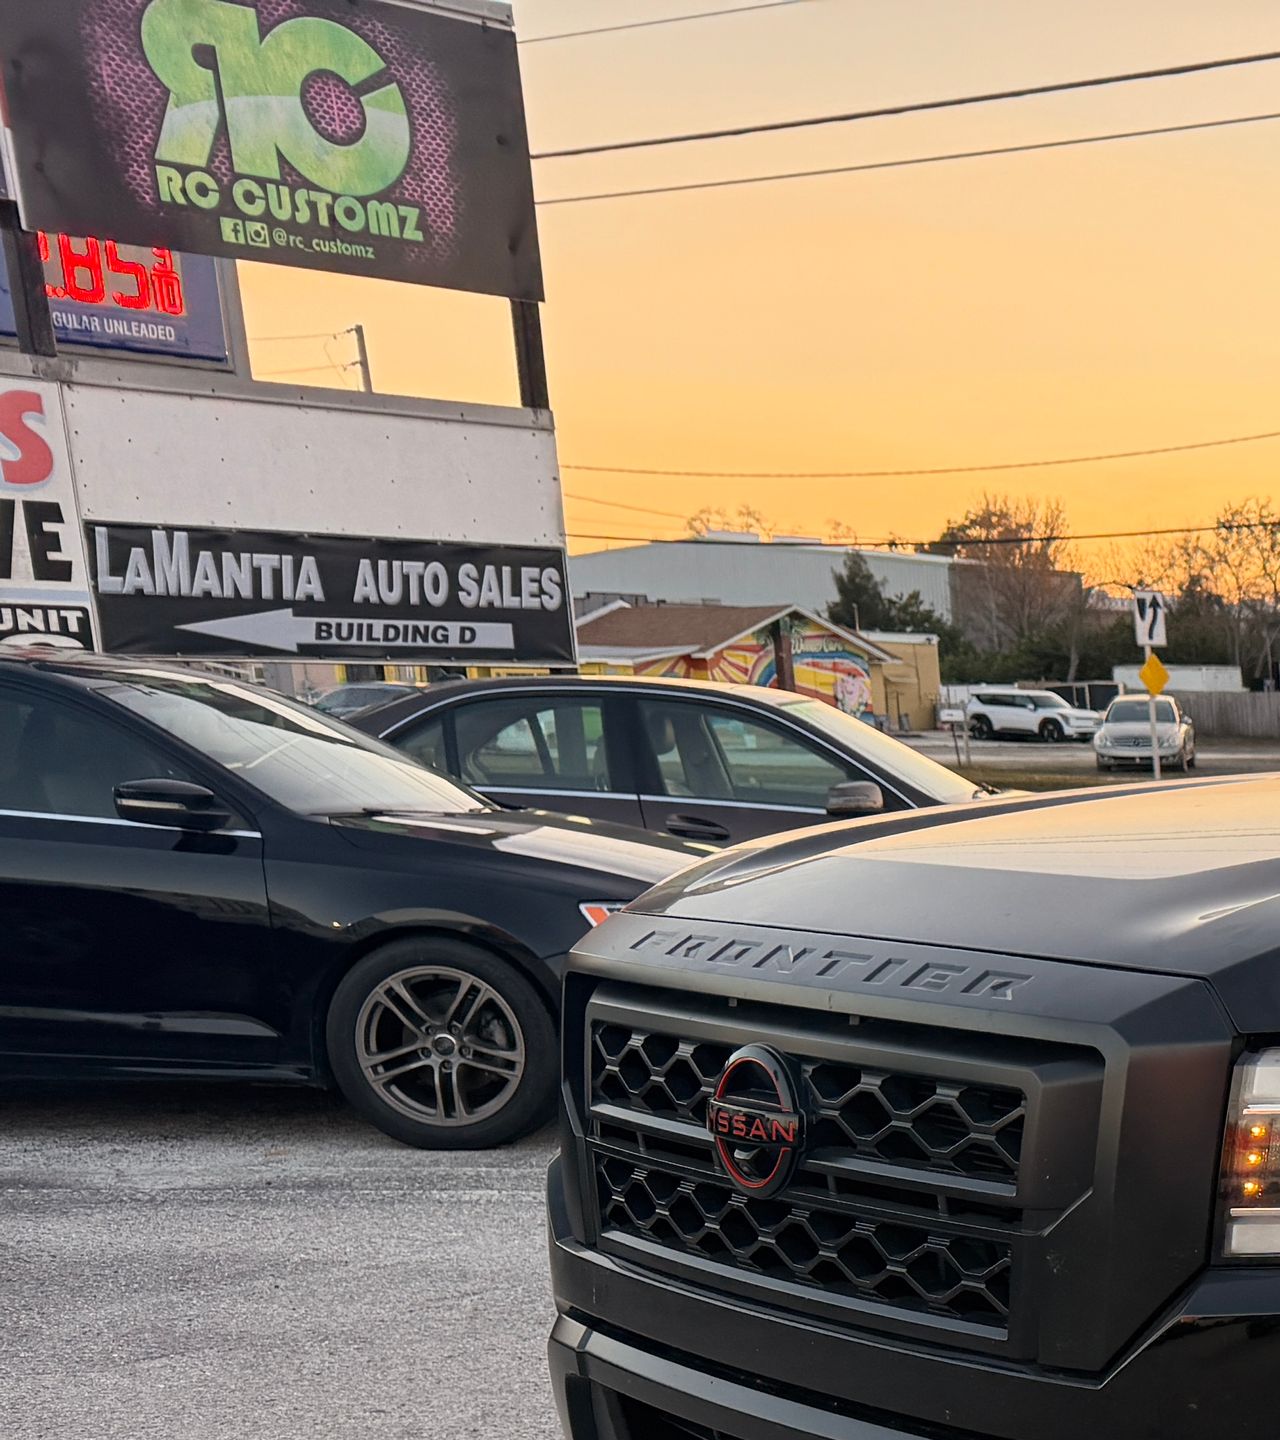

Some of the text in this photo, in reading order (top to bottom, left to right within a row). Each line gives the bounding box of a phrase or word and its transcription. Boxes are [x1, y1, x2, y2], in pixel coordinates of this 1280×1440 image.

[155, 165, 425, 242] RC CUSTOMZ
[272, 228, 376, 260] @rc_customz
[104, 318, 175, 341] UNLEADED
[353, 558, 450, 607] AUTO
[458, 563, 562, 612] SALES
[315, 621, 477, 644] BUILDING D
[629, 930, 1036, 1000] FRONTIER
